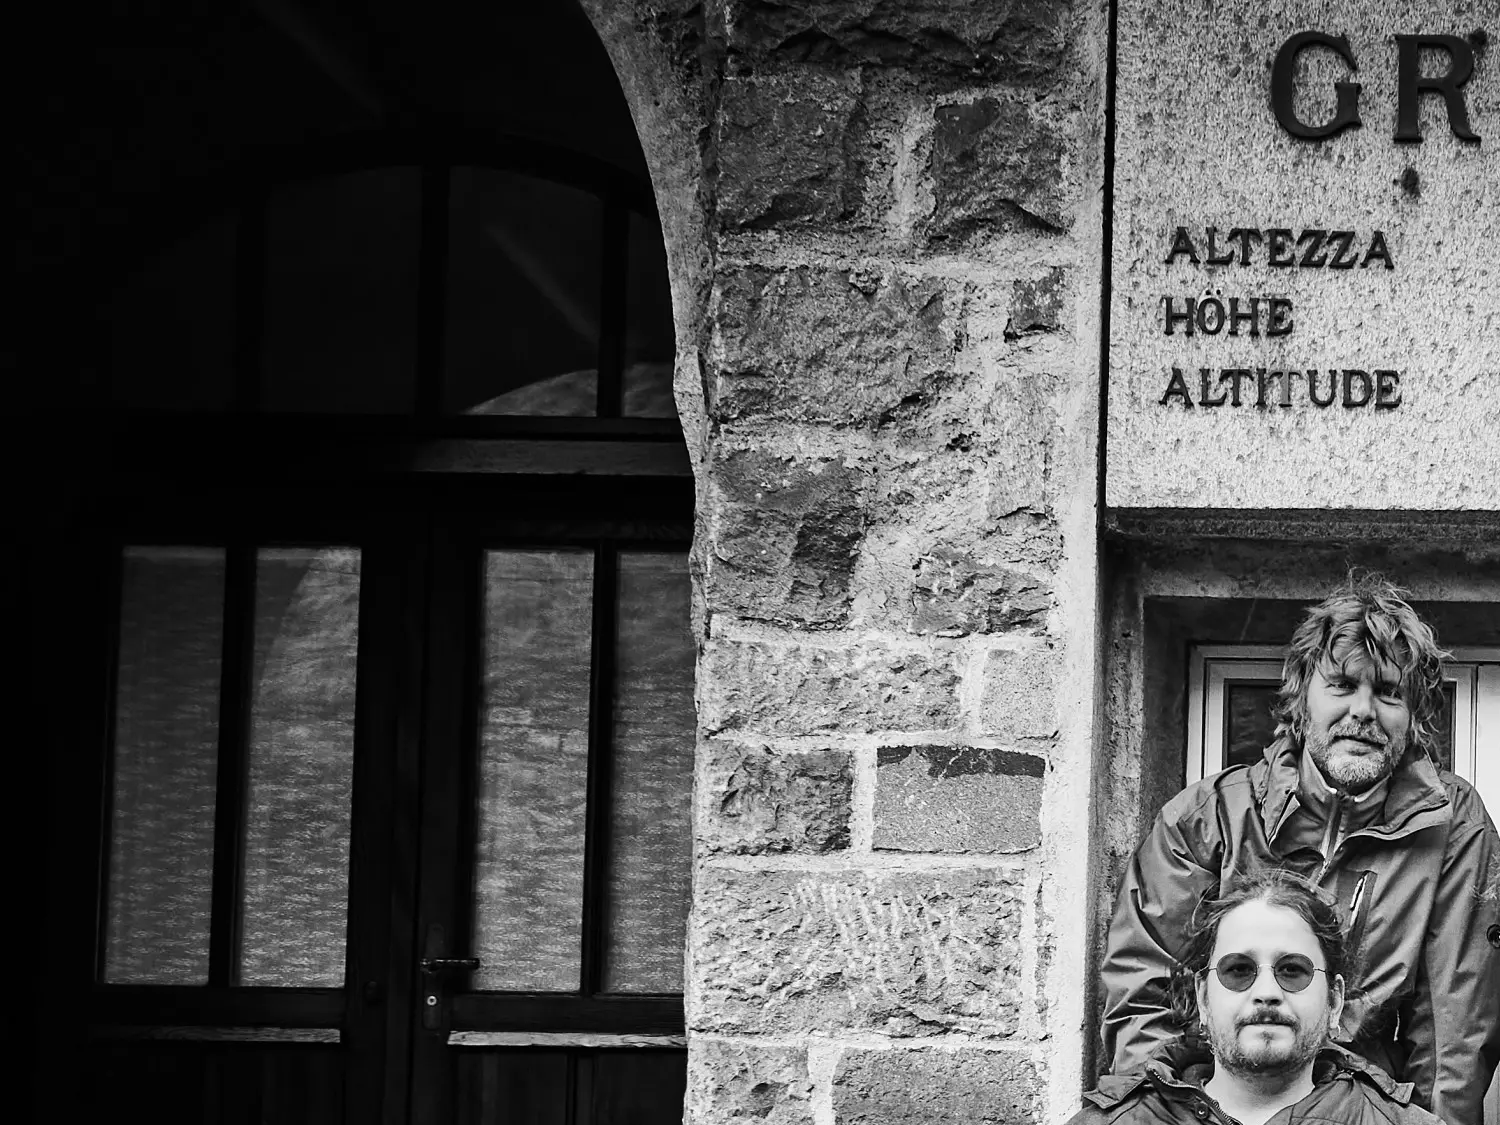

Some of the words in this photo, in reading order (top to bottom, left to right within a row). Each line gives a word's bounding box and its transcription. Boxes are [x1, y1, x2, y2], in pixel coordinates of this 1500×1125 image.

[1165, 227, 1395, 269] ALTEZZA
[1162, 289, 1294, 336] HÖHE
[1159, 367, 1402, 408] ALTITUDE
